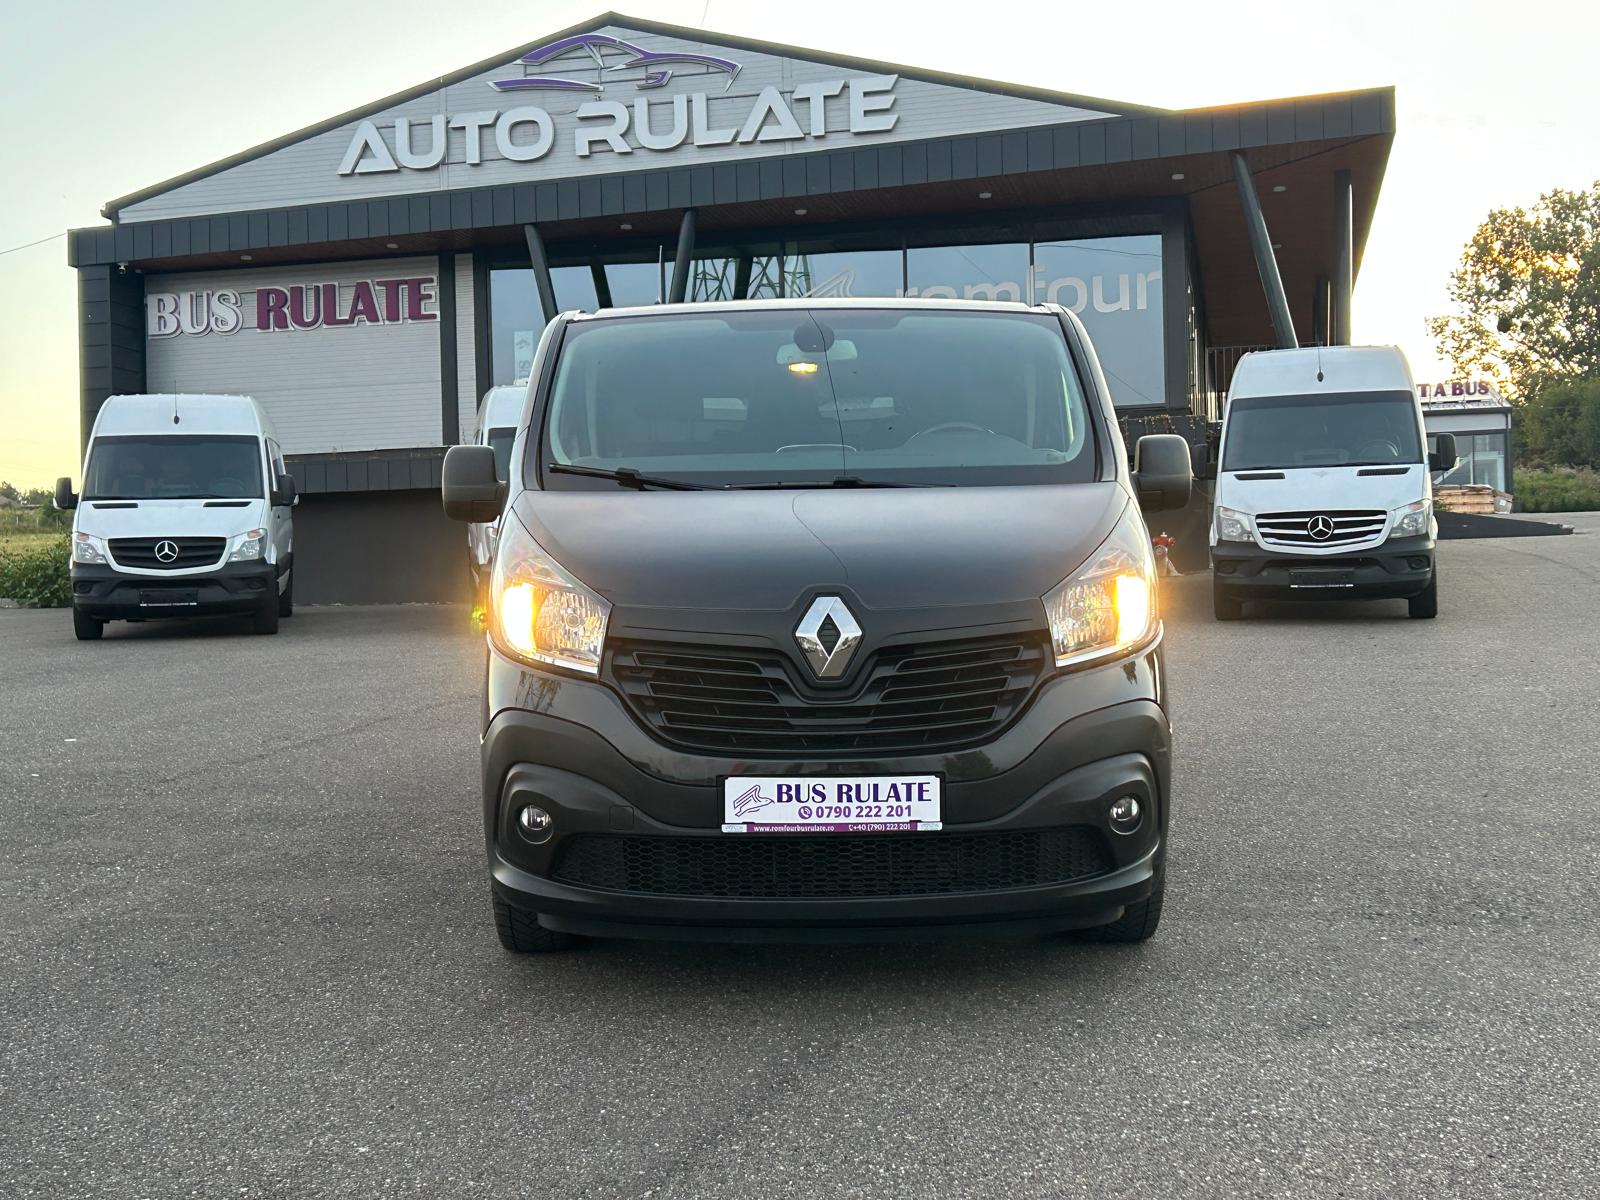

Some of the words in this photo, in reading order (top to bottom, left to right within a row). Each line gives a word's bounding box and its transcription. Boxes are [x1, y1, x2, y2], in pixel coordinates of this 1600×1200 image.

[336, 106, 555, 176] AUTO
[574, 73, 900, 158] RULATE
[896, 264, 1161, 315] mfour
[147, 288, 243, 339] BUS
[256, 275, 440, 333] RULATE
[1434, 383, 1446, 397] A
[1451, 380, 1489, 397] BUS
[776, 783, 826, 804] BUS
[837, 782, 932, 803] RULATE
[815, 805, 851, 818] 0790
[855, 805, 882, 818] 222
[886, 804, 912, 818] 201
[753, 824, 835, 832] www.romfourbusrulate.ro
[886, 823, 898, 831] 222
